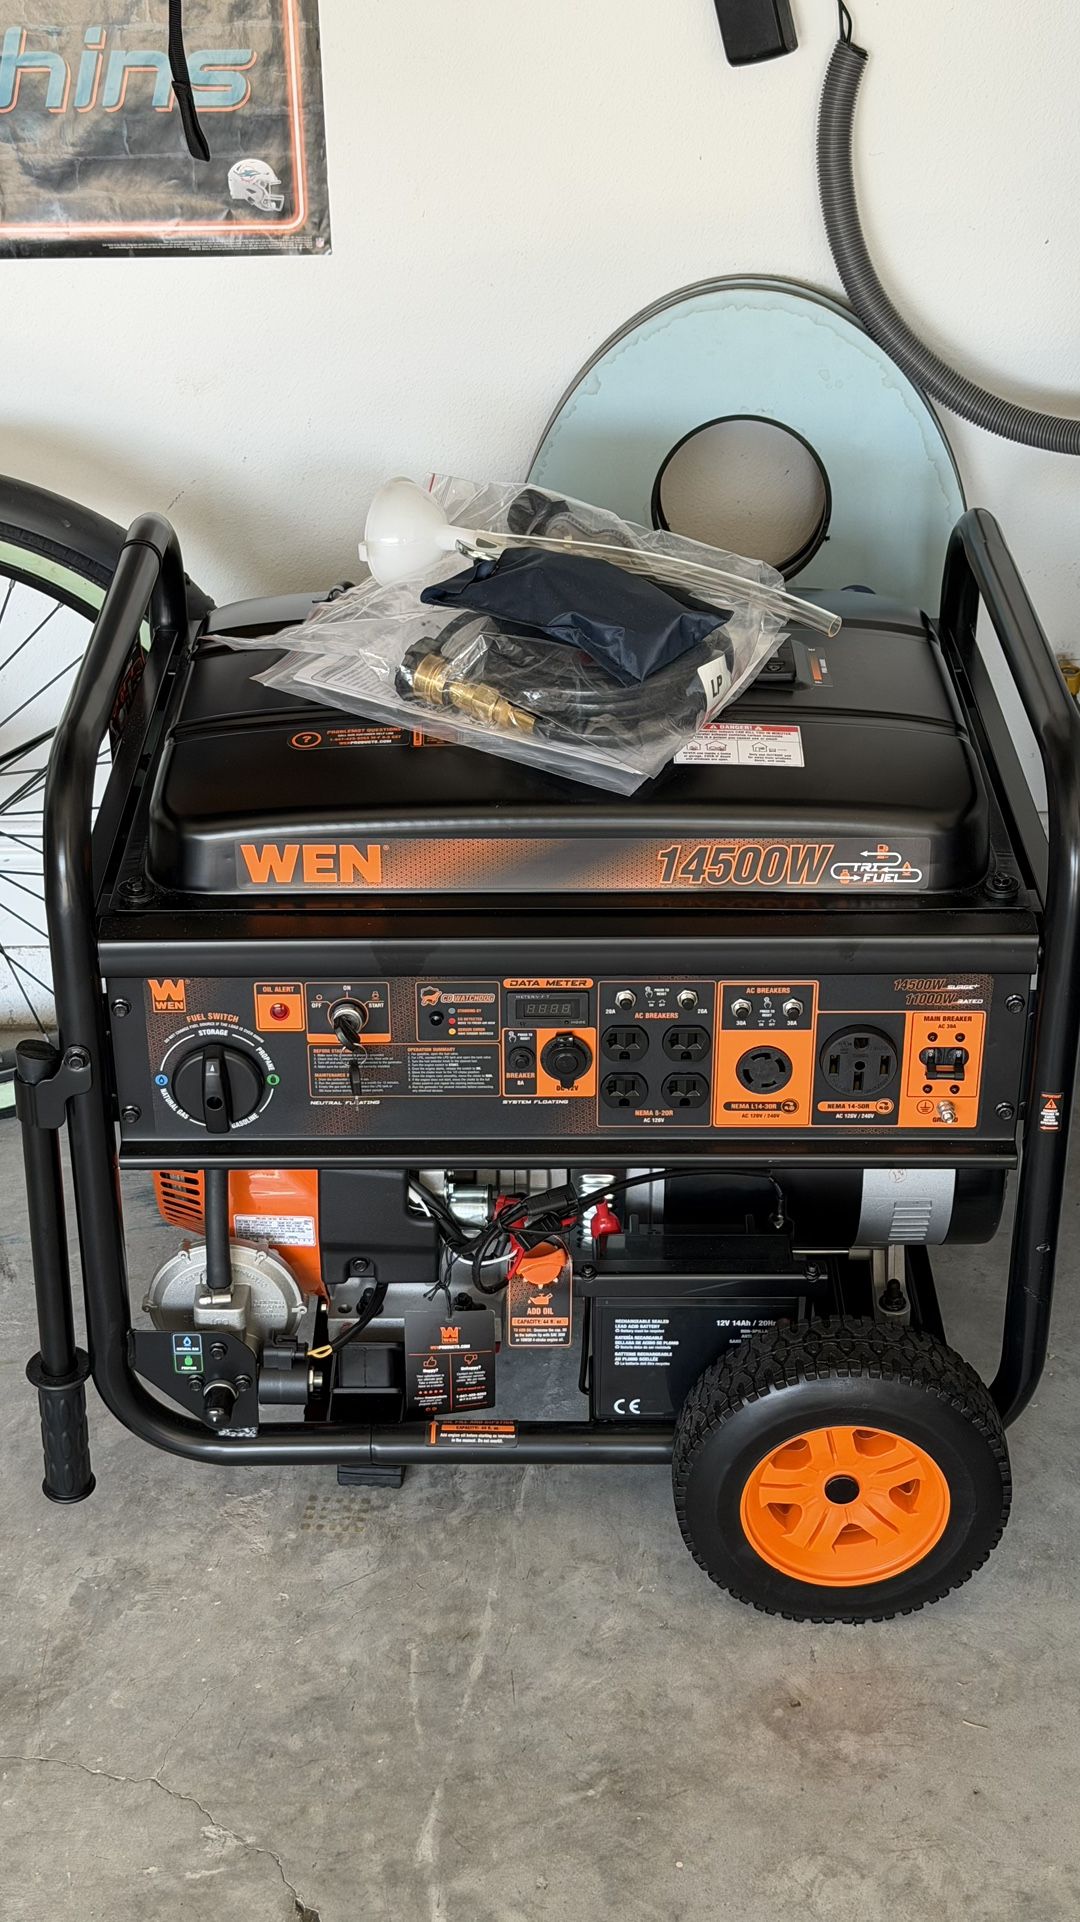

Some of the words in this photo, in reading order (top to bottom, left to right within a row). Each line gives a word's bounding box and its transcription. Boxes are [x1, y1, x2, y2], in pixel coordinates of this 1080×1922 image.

[710, 674, 723, 698] LP
[240, 844, 381, 883] WEN
[657, 844, 834, 885] 14500W
[852, 862, 880, 873] TRI
[862, 874, 901, 883] FUEL
[509, 979, 540, 987] DATA
[545, 979, 588, 987] METER
[893, 978, 946, 991] 14500W
[906, 993, 957, 1005] 11000W
[155, 1001, 184, 1010] WEN
[186, 1014, 205, 1023] FUEL
[207, 1012, 240, 1023] SWITCH
[198, 1028, 229, 1037] STORAGE
[255, 1046, 276, 1072] PROPANE
[160, 1088, 179, 1112] NATURAL
[176, 1108, 190, 1120] GAS
[231, 1112, 260, 1129] GASOLINE
[527, 1307, 541, 1315] ADD
[542, 1307, 554, 1315] OIL
[716, 1319, 731, 1327] 12V
[732, 1319, 751, 1327] 14Ah
[613, 1398, 641, 1415] CE
